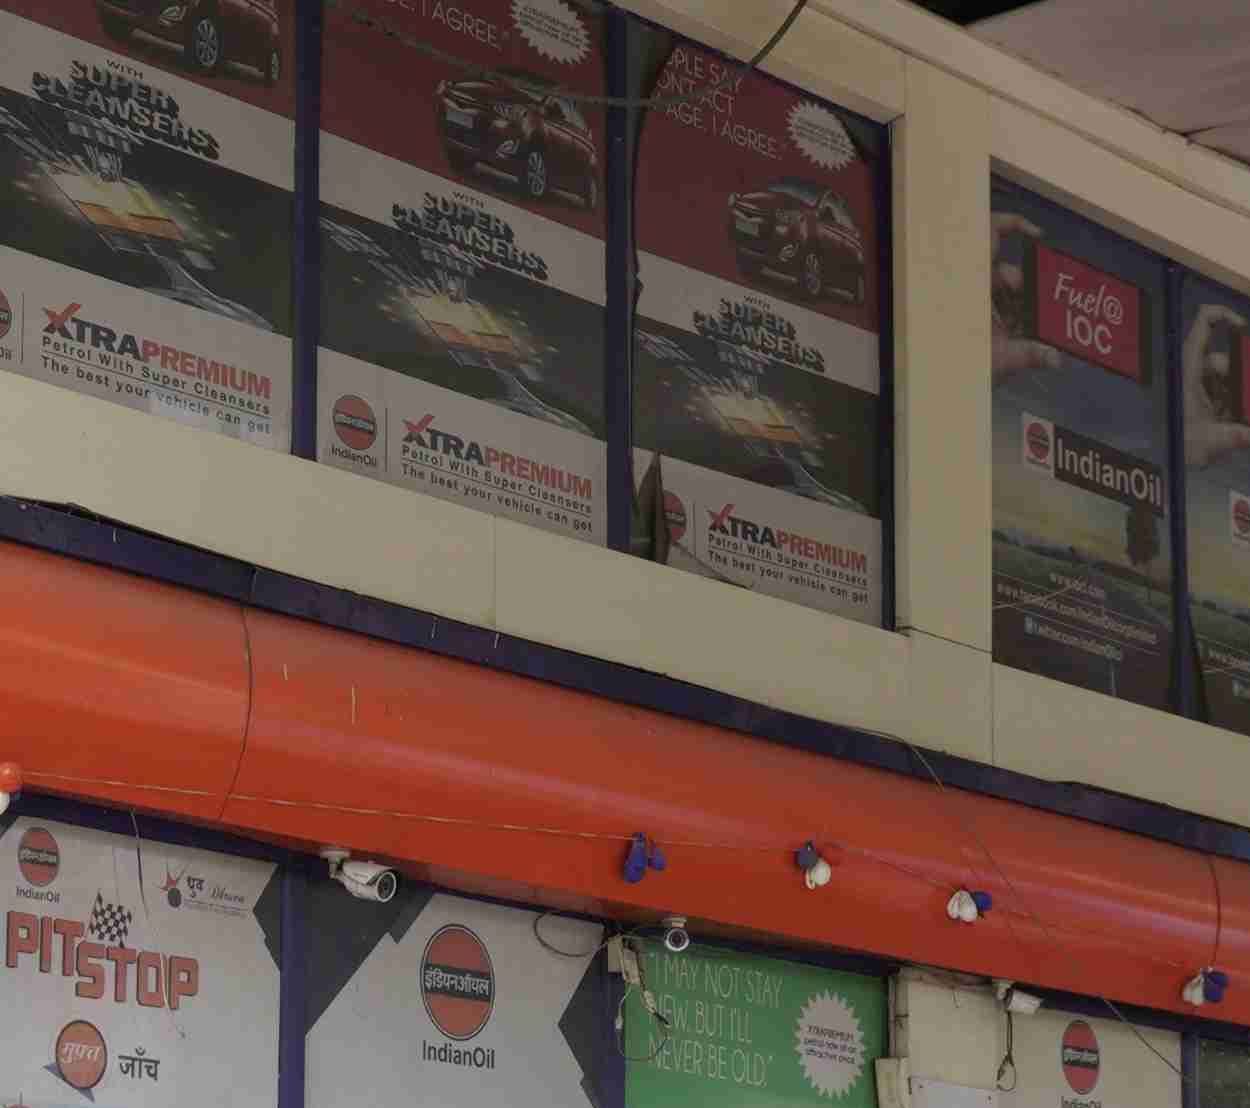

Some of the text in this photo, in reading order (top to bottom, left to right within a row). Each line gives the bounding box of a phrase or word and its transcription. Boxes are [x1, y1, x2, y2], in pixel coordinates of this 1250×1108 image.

[71, 59, 181, 117] SUPER
[106, 59, 144, 80] WITH
[32, 72, 221, 160] CLEANSERS
[424, 192, 514, 240] SUPER
[1065, 310, 1113, 356] IOC
[41, 355, 271, 436] The best your vehicle can get
[42, 337, 93, 361] Petrol
[99, 351, 135, 375] With
[141, 365, 187, 392] Super
[194, 381, 271, 416] Cleansers
[402, 445, 592, 515] Petrol With Super Cleansers
[1057, 438, 1161, 506] IndianOil
[402, 465, 592, 534] The best your vehicle can get
[708, 534, 868, 587] Petrol With Super Cleansers
[708, 552, 868, 606] The best your vehicle can get
[16, 887, 60, 903] IndianOil
[6, 911, 84, 976] PIT
[75, 940, 199, 1010] STOP
[664, 955, 784, 1009] MAY NOT STAY
[696, 1001, 726, 1039] BUT
[422, 1040, 496, 1069] IndianOil
[707, 1044, 728, 1081] BE
